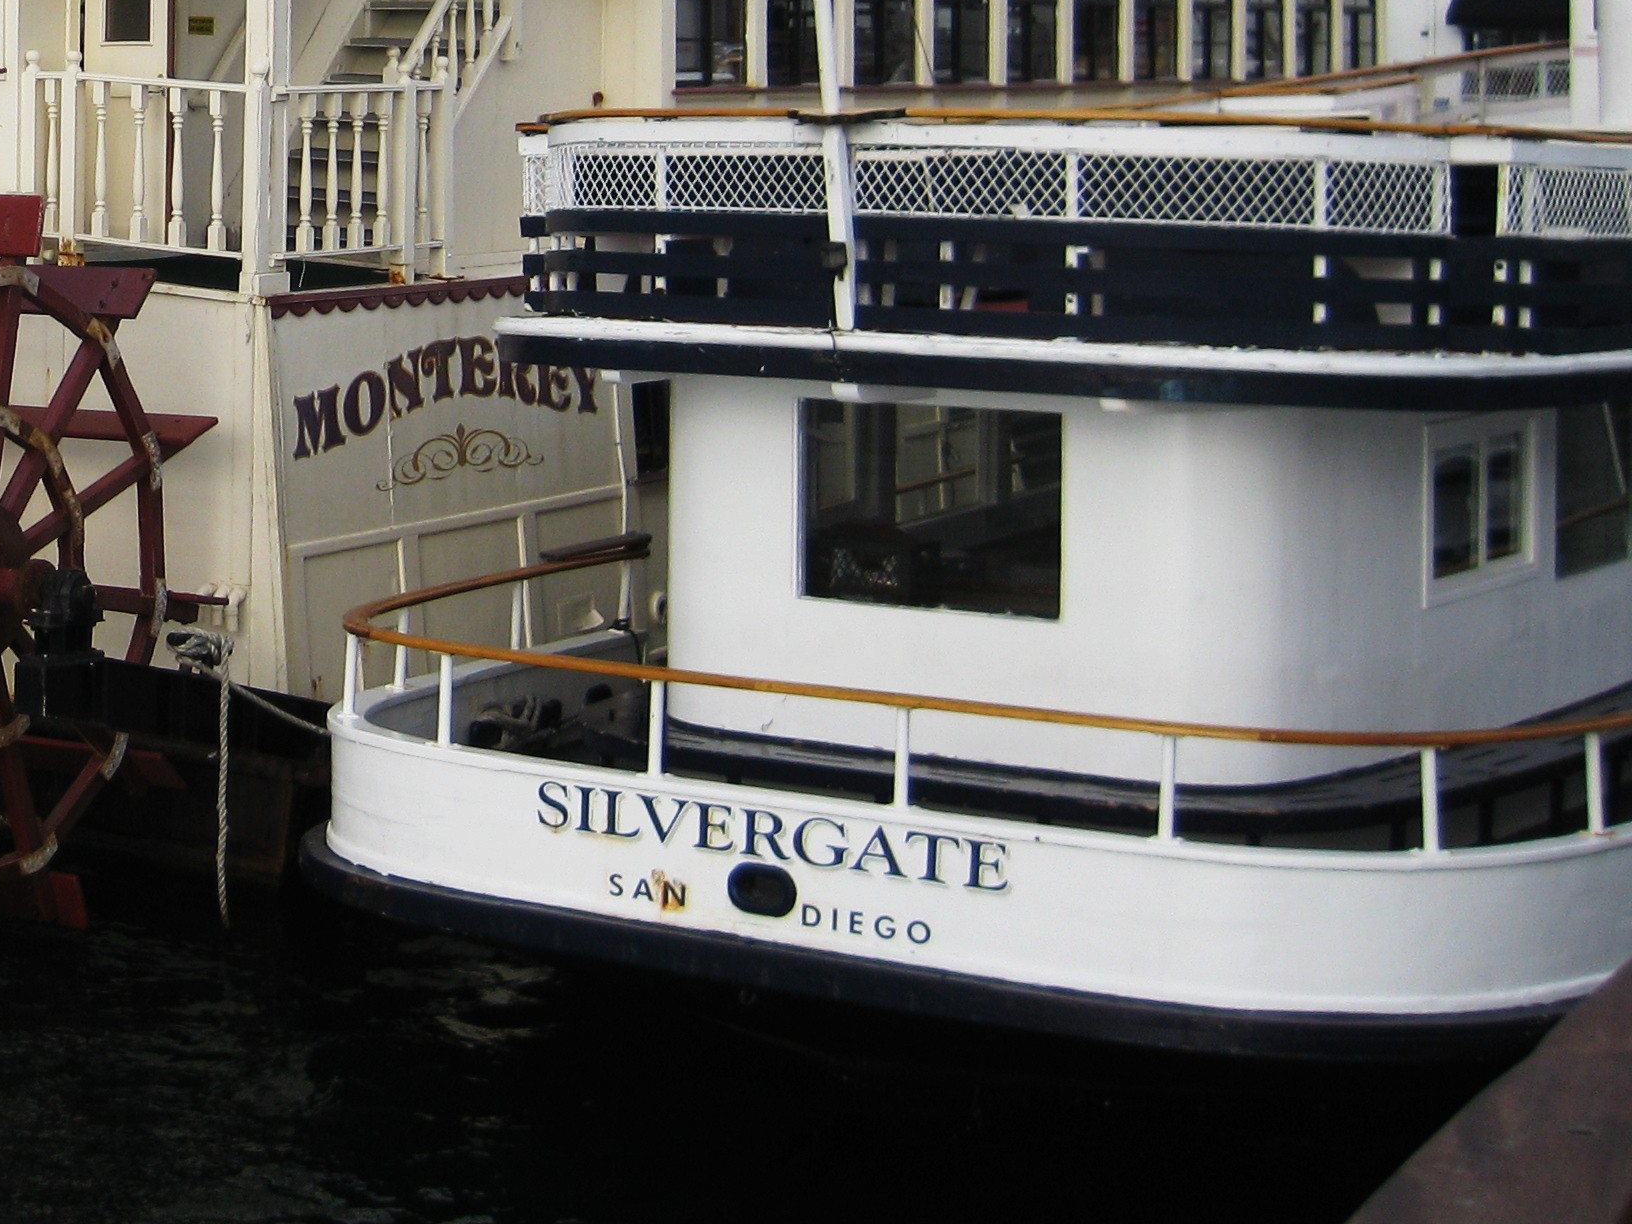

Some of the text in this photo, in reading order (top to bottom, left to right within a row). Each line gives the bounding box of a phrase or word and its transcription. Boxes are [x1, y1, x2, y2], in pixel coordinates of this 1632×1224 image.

[536, 779, 1012, 894] SILVERGATE
[608, 872, 933, 945] SAN DIEGO
